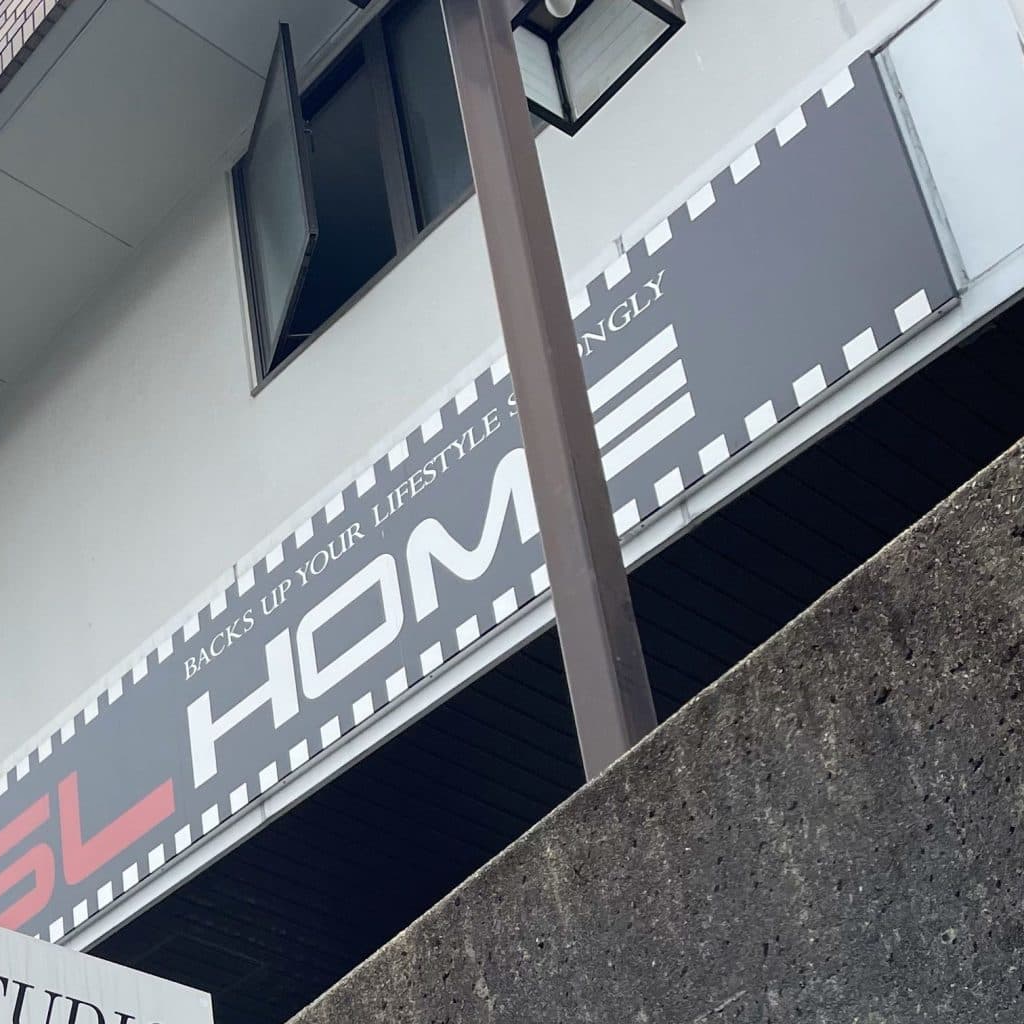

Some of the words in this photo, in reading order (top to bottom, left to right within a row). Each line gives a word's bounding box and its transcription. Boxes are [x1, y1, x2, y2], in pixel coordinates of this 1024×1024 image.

[183, 609, 255, 681] BACKS
[261, 579, 292, 616] UP
[295, 522, 365, 587] YOUR
[372, 408, 502, 528] LIFESTYLE
[187, 324, 696, 789] HOME
